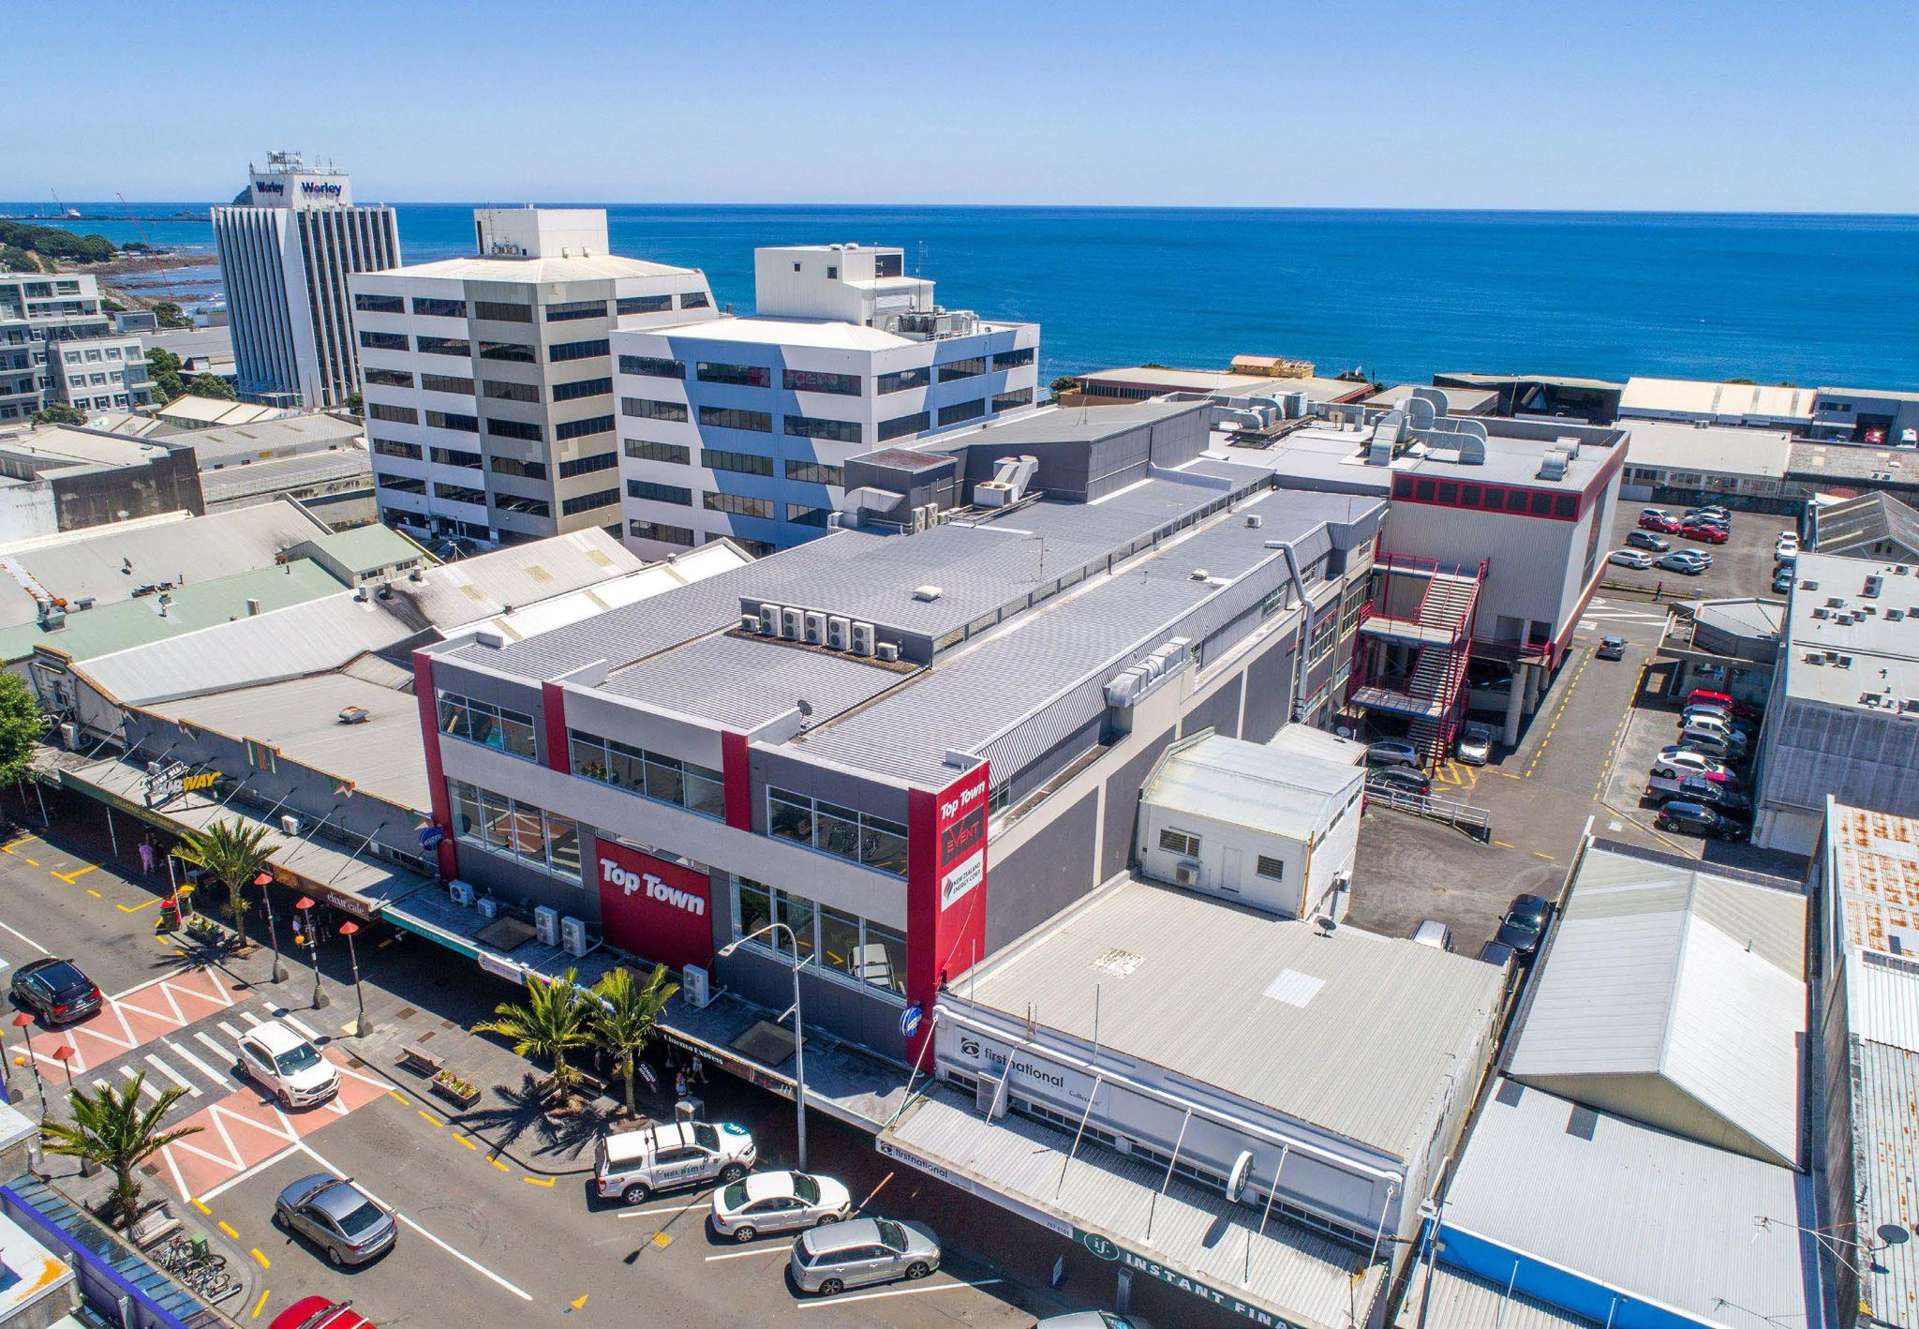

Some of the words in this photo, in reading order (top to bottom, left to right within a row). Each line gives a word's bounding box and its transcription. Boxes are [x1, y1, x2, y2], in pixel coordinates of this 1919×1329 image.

[256, 181, 284, 196] Worley
[301, 182, 342, 197] Worley
[941, 800, 959, 820] Top
[960, 781, 985, 806] Town
[600, 858, 641, 896] Top
[642, 873, 705, 916] Town
[1126, 1253, 1224, 1304] INSTANT
[1234, 1301, 1298, 1329] FINA
